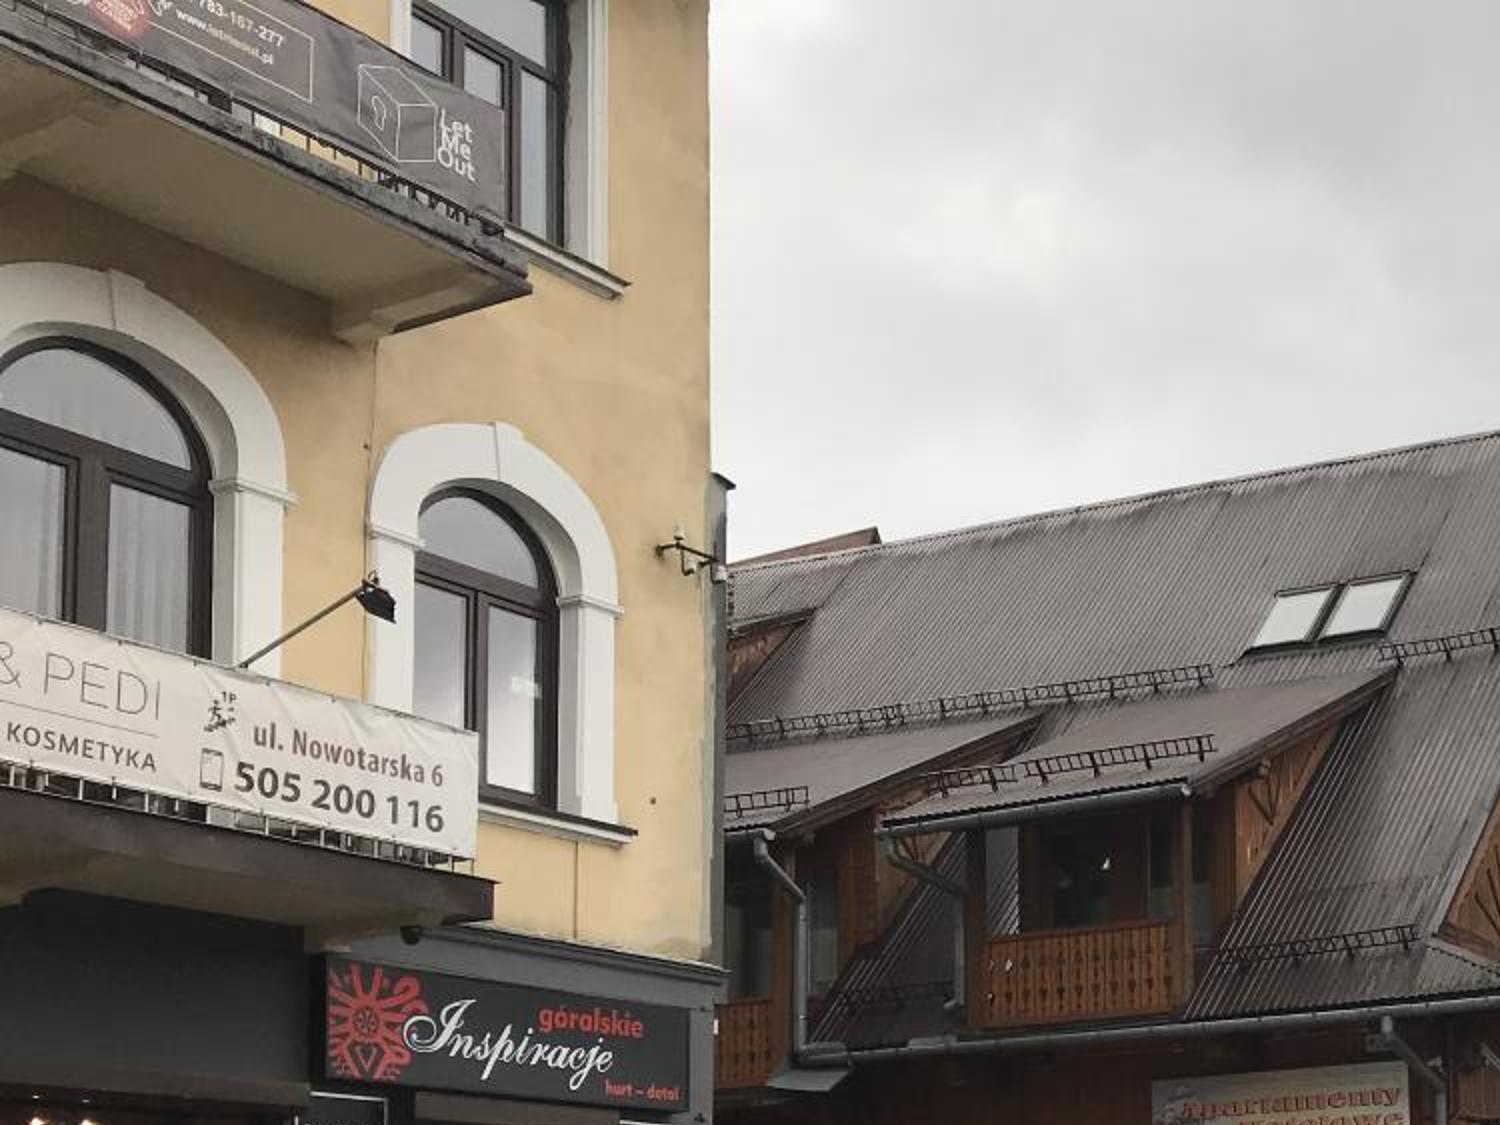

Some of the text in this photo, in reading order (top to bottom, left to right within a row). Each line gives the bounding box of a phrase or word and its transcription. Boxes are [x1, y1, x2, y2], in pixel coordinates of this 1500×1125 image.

[440, 108, 472, 143] Let
[437, 146, 476, 182] Out
[44, 652, 160, 721] PEDI
[7, 721, 157, 773] KOSMETYKA
[253, 722, 445, 787] ul. Nowotarska 6
[234, 761, 445, 833] 505 200 116
[403, 999, 614, 1090] Inspiracje
[539, 1006, 644, 1039] góralskie
[605, 1080, 633, 1097] hurt
